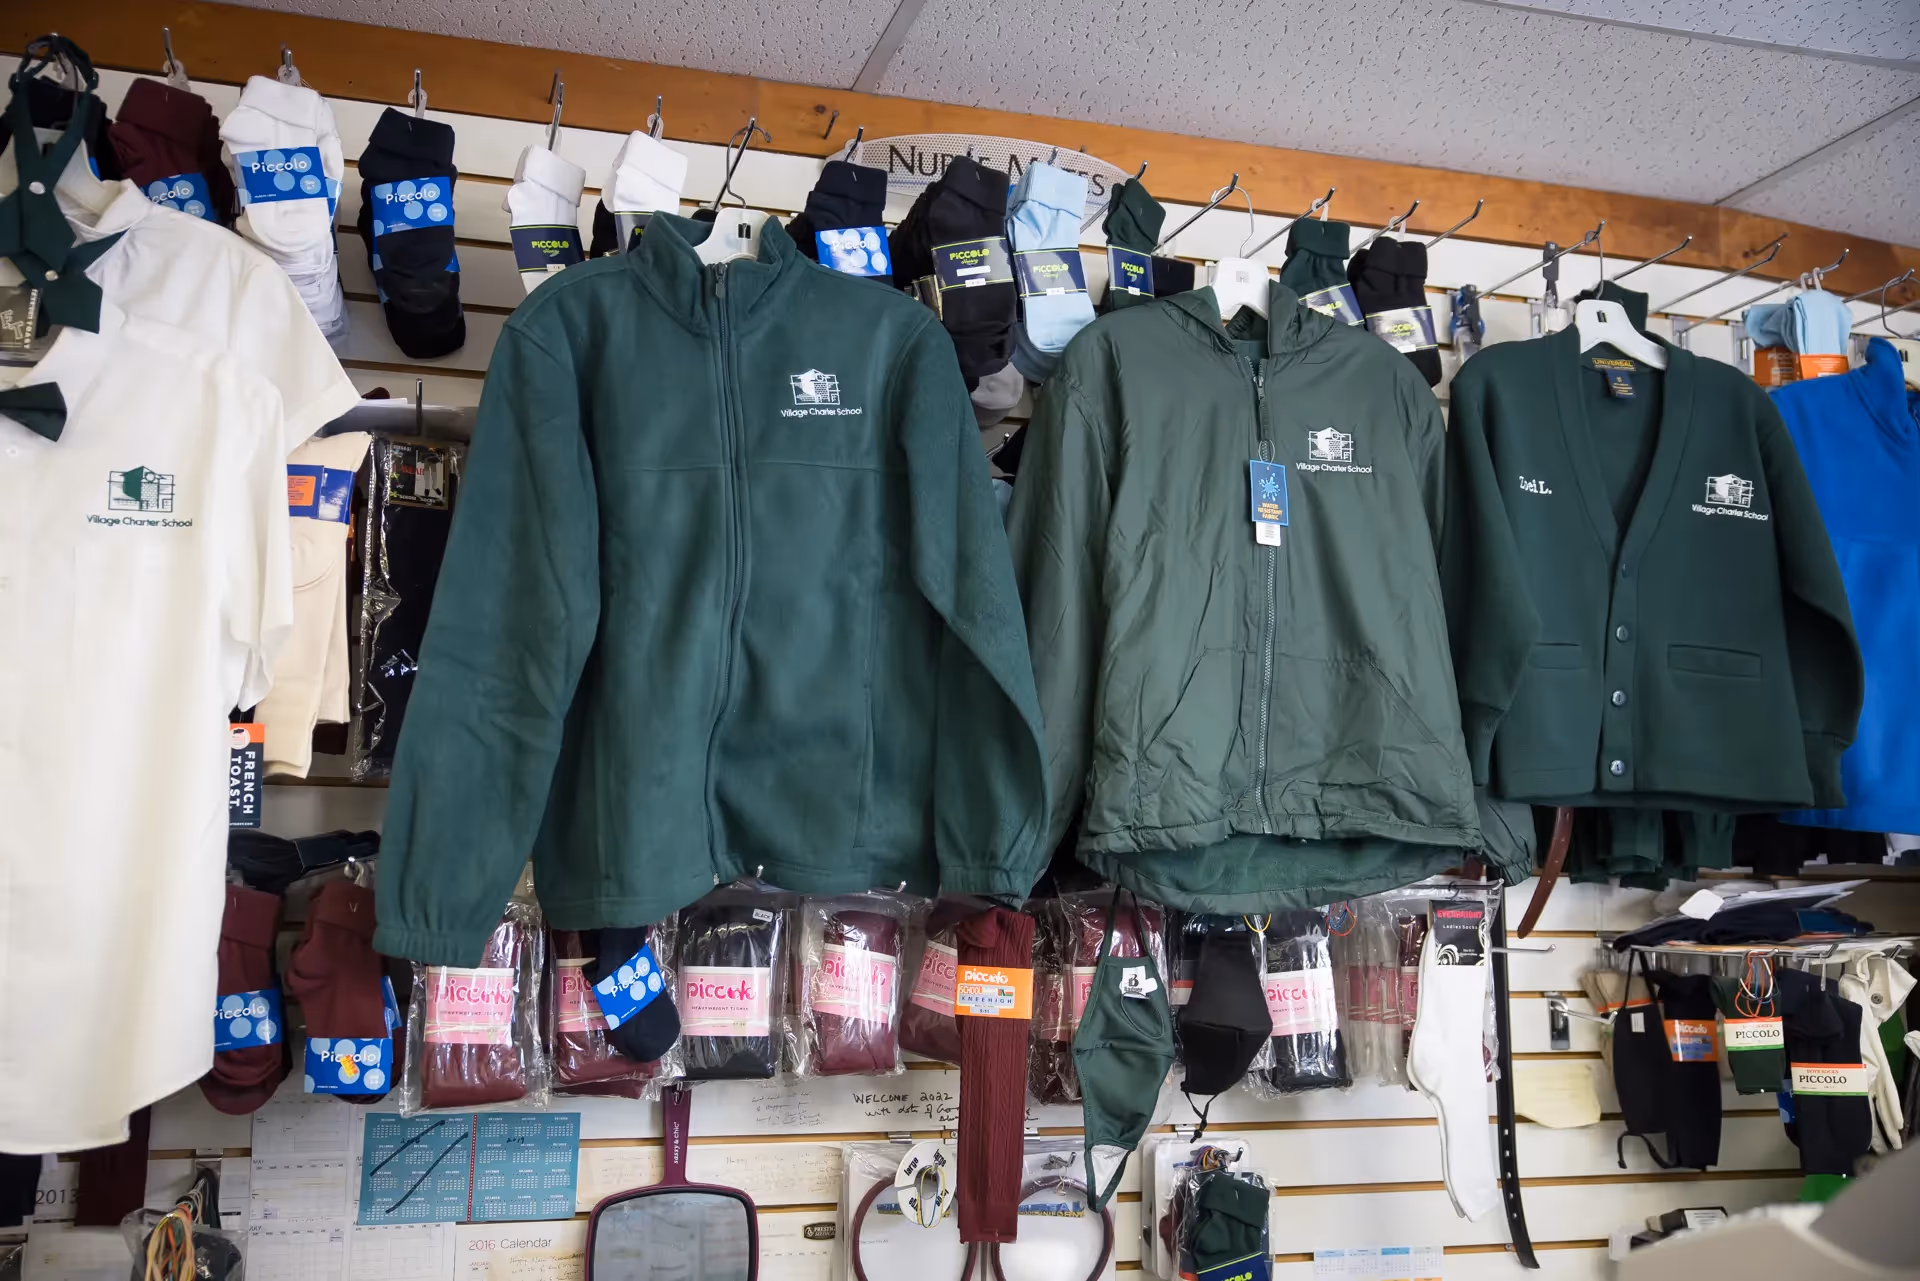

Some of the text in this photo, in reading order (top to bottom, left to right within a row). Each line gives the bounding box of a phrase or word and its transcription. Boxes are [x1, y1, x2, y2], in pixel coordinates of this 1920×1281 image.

[251, 158, 308, 174] Piccolo
[386, 189, 436, 205] Piccolo
[780, 406, 862, 418] Village Charter School
[1296, 462, 1372, 474] Village Charter School
[1691, 504, 1768, 521] Village Charter School
[86, 514, 193, 527] Village Charter School
[242, 751, 256, 814] FRENCH
[611, 963, 648, 998] Piccolo
[1735, 1029, 1780, 1039] PICCOLO
[321, 1050, 377, 1063] Picolo
[1799, 1074, 1848, 1085] PICCOLO
[920, 1091, 953, 1102] 2022
[673, 1145, 681, 1165] sassy
[904, 1157, 919, 1177] large
[468, 1237, 552, 1251] 2016 Calendar
